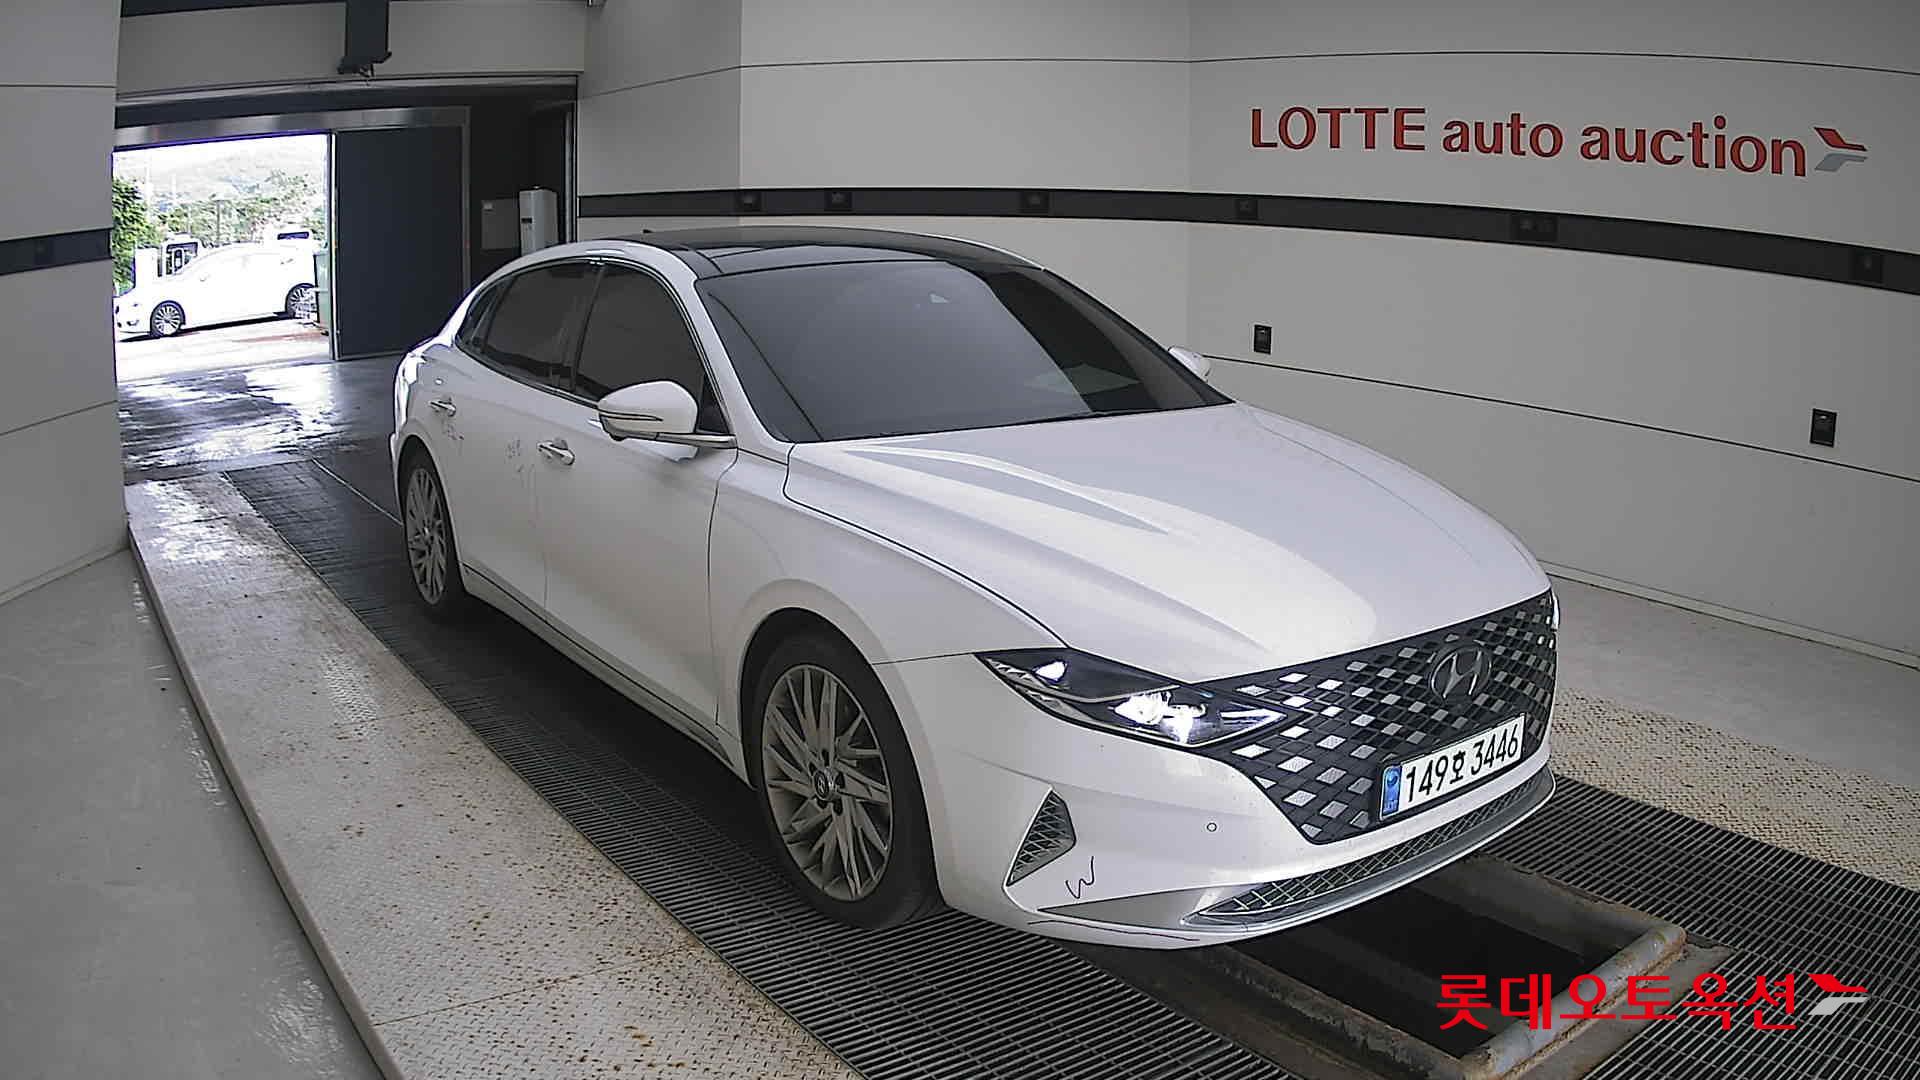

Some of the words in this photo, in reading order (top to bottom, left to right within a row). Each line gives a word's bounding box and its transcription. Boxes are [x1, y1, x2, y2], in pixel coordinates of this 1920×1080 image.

[1250, 107, 1426, 151] LOTTE
[1442, 112, 1563, 159] auto
[1580, 115, 1807, 177] auction
[1406, 751, 1466, 803] 149호
[1471, 723, 1518, 776] 3446
